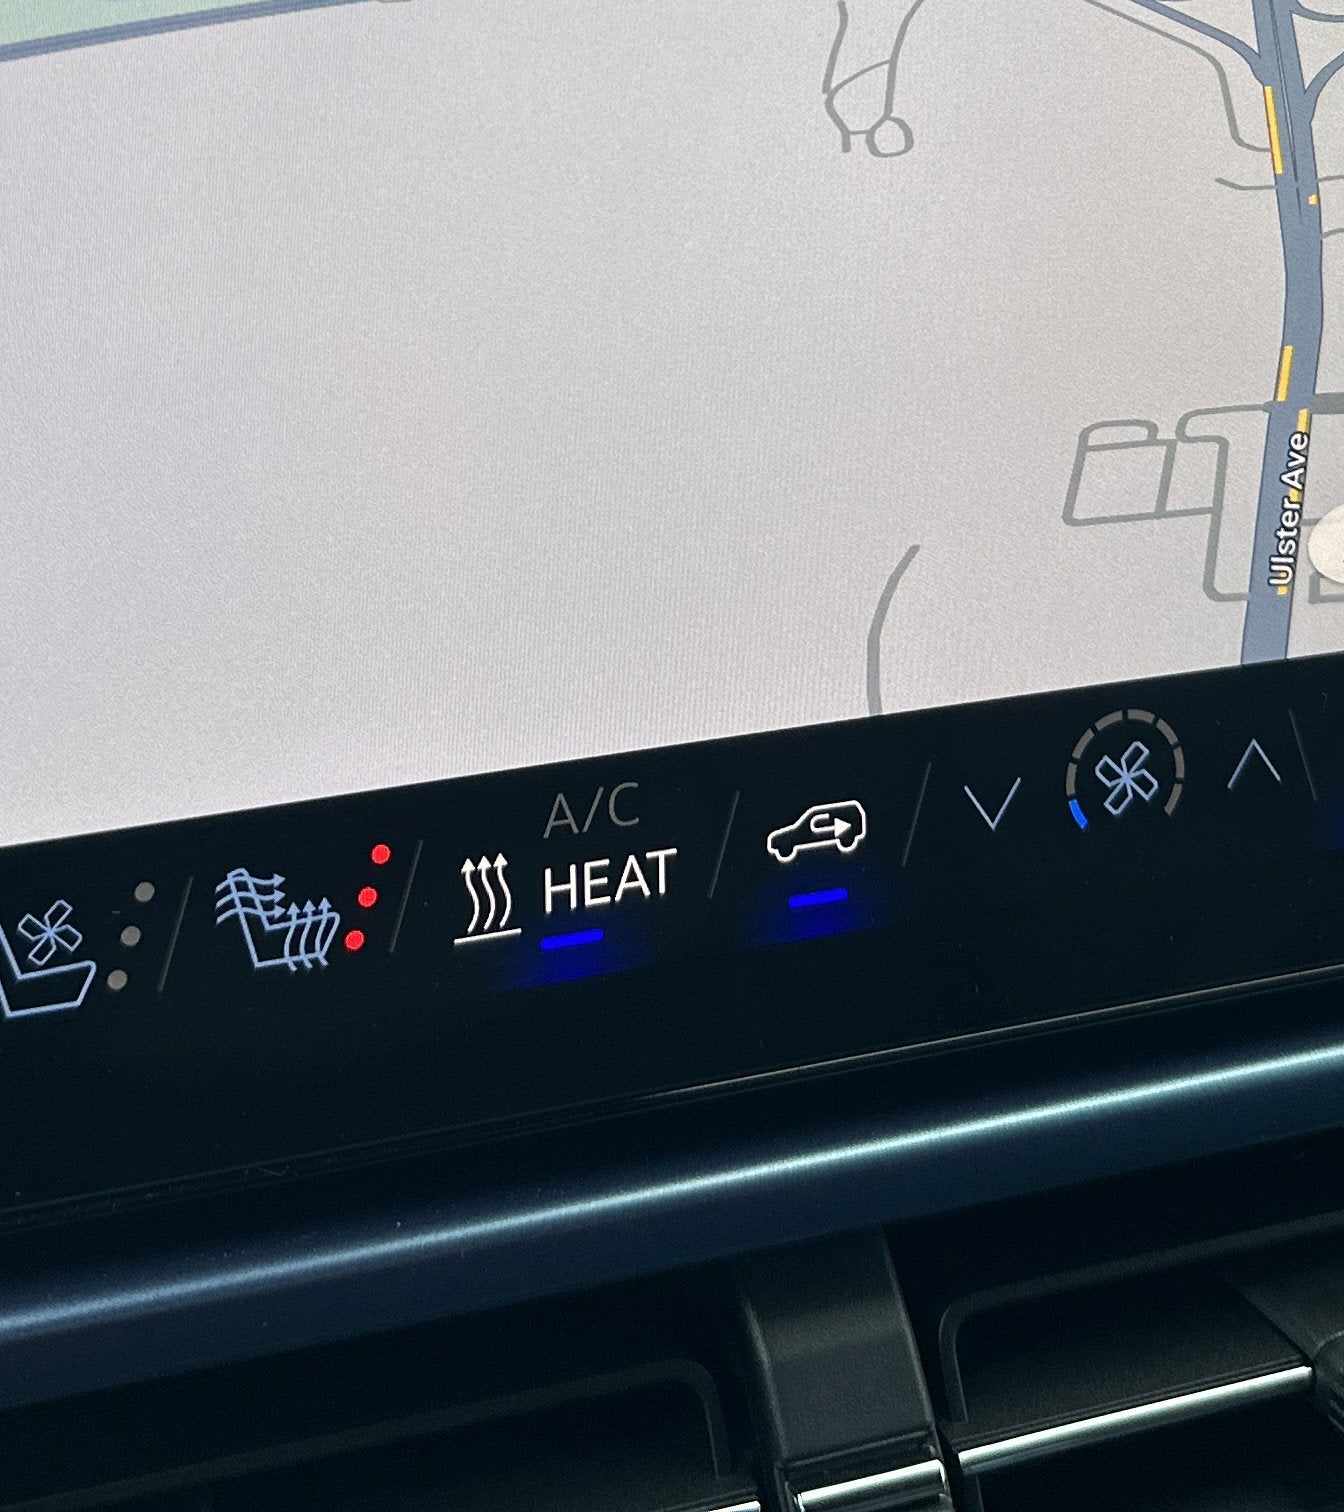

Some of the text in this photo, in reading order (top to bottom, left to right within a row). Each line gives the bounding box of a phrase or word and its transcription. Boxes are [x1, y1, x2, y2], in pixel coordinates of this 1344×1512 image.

[1268, 431, 1309, 587] Ulster Ave
[543, 782, 640, 839] A/C
[543, 847, 678, 916] HEAT
